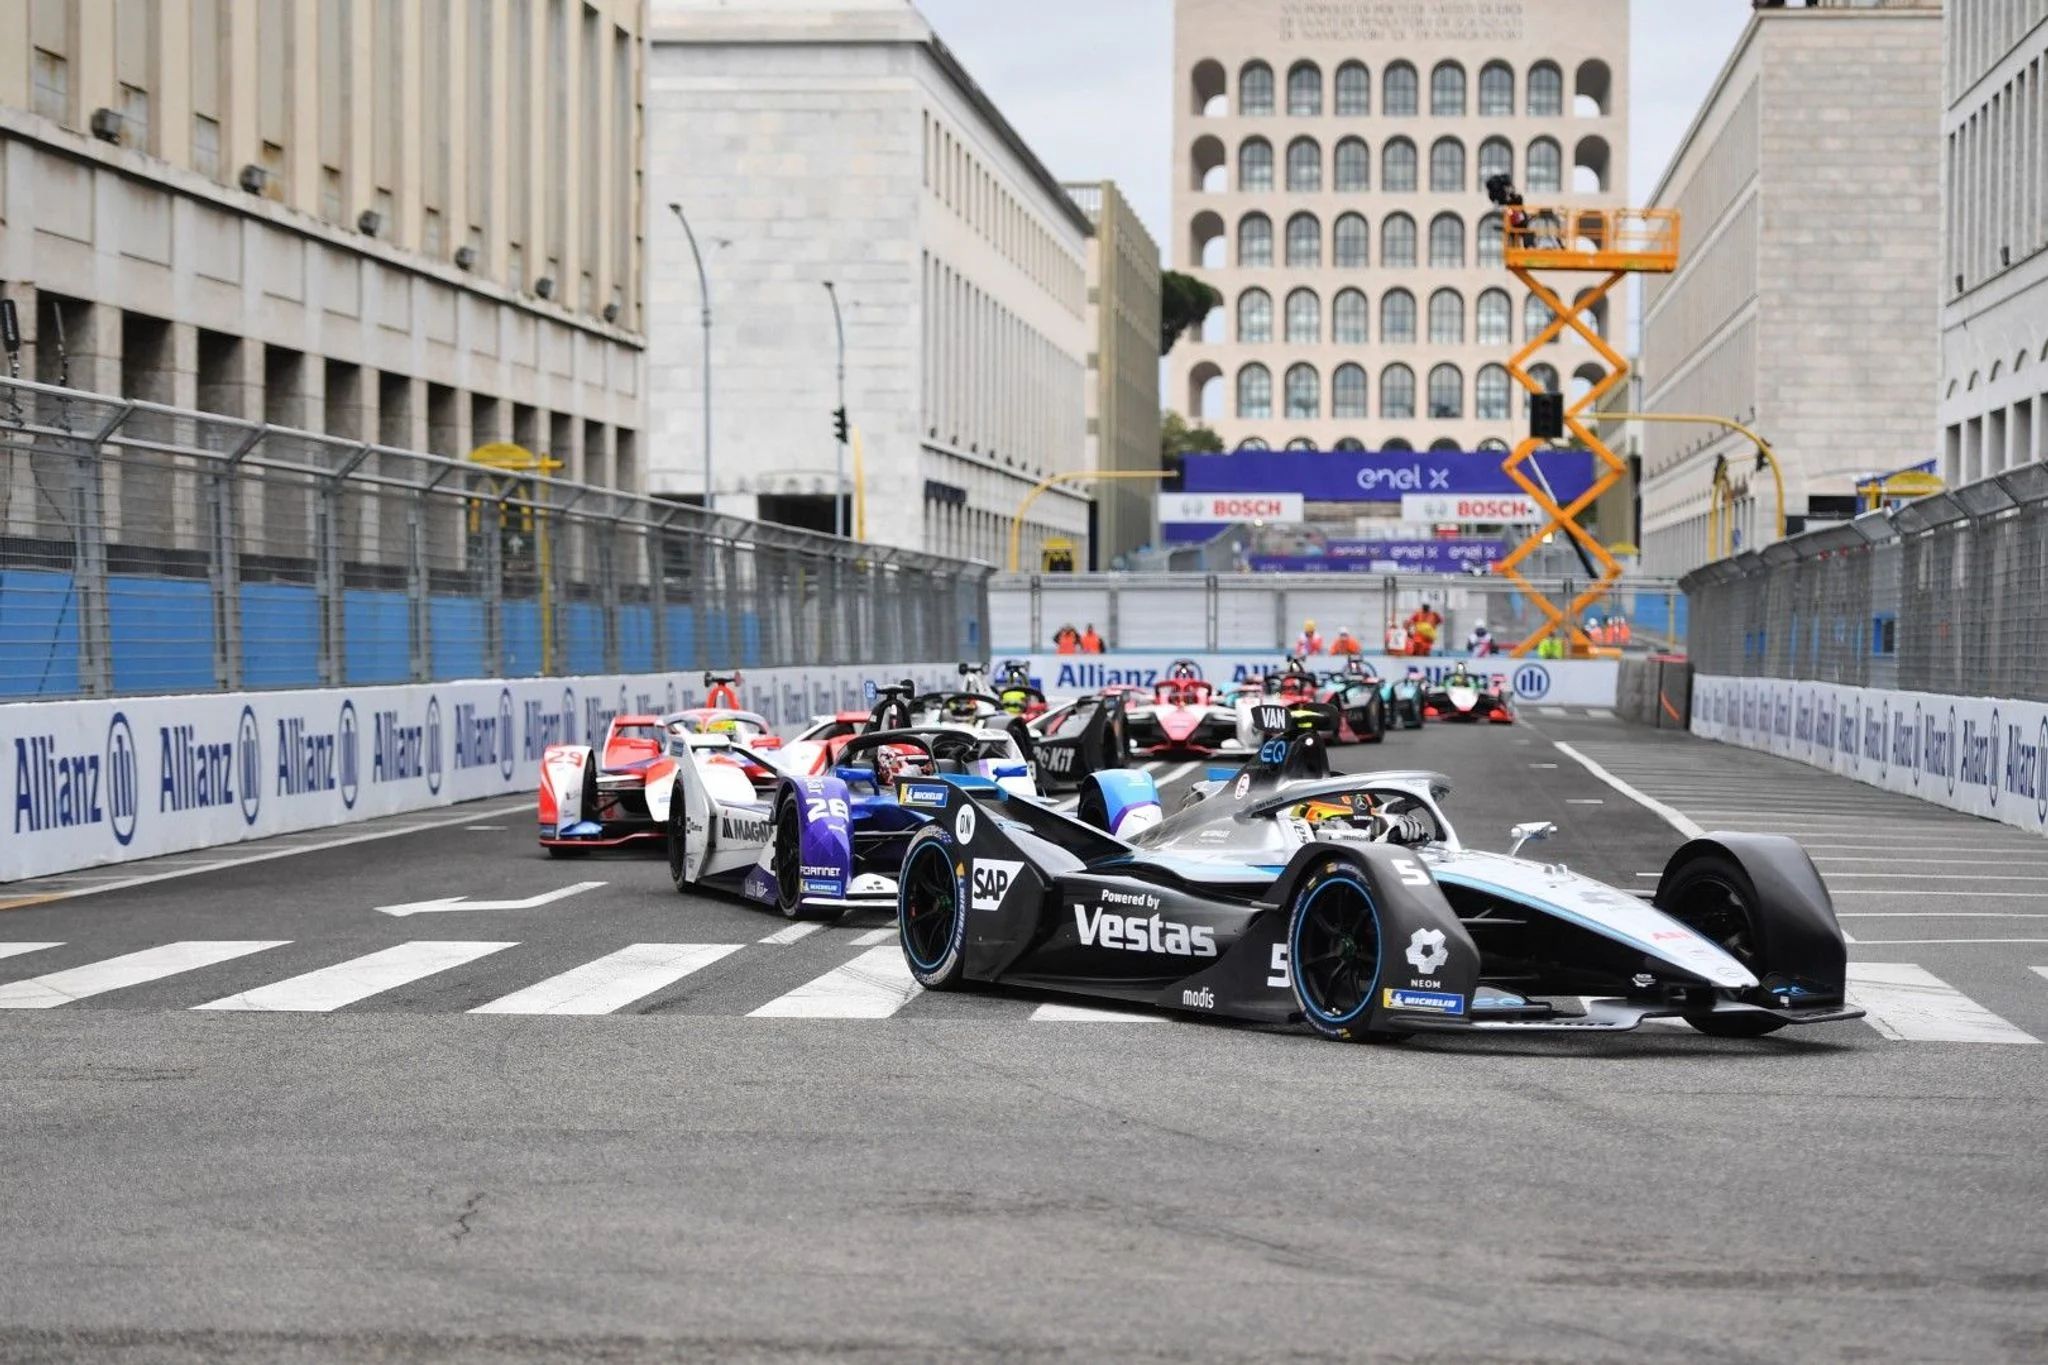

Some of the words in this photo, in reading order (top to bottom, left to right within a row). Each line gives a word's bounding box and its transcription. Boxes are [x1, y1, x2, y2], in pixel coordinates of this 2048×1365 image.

[1357, 466, 1421, 489] enel
[1213, 500, 1282, 517] BOSCH
[1457, 501, 1527, 517] BOSCH
[1057, 662, 1158, 688] Allianz
[1261, 707, 1286, 729] VAN
[373, 710, 423, 783] Allianz
[454, 703, 496, 770] Allianz
[277, 717, 335, 797] Allianz
[548, 751, 584, 768] 29
[1261, 740, 1286, 764] EQ
[1960, 719, 1989, 785] Allianz
[2005, 724, 2037, 799] Allianz
[160, 725, 233, 813] Allianz
[14, 734, 102, 834] Allianz
[913, 790, 944, 801] MICHELIN
[959, 814, 972, 835] ON
[973, 867, 1009, 901] SAP
[1391, 859, 1431, 886] 5
[1101, 889, 1146, 906] Powered
[1147, 895, 1161, 910] by
[1073, 903, 1218, 957] Vestas
[1266, 942, 1292, 988] 5
[1410, 979, 1441, 989] NEOM
[1182, 986, 1215, 1009] modis
[1404, 996, 1457, 1008] MICHELIN
